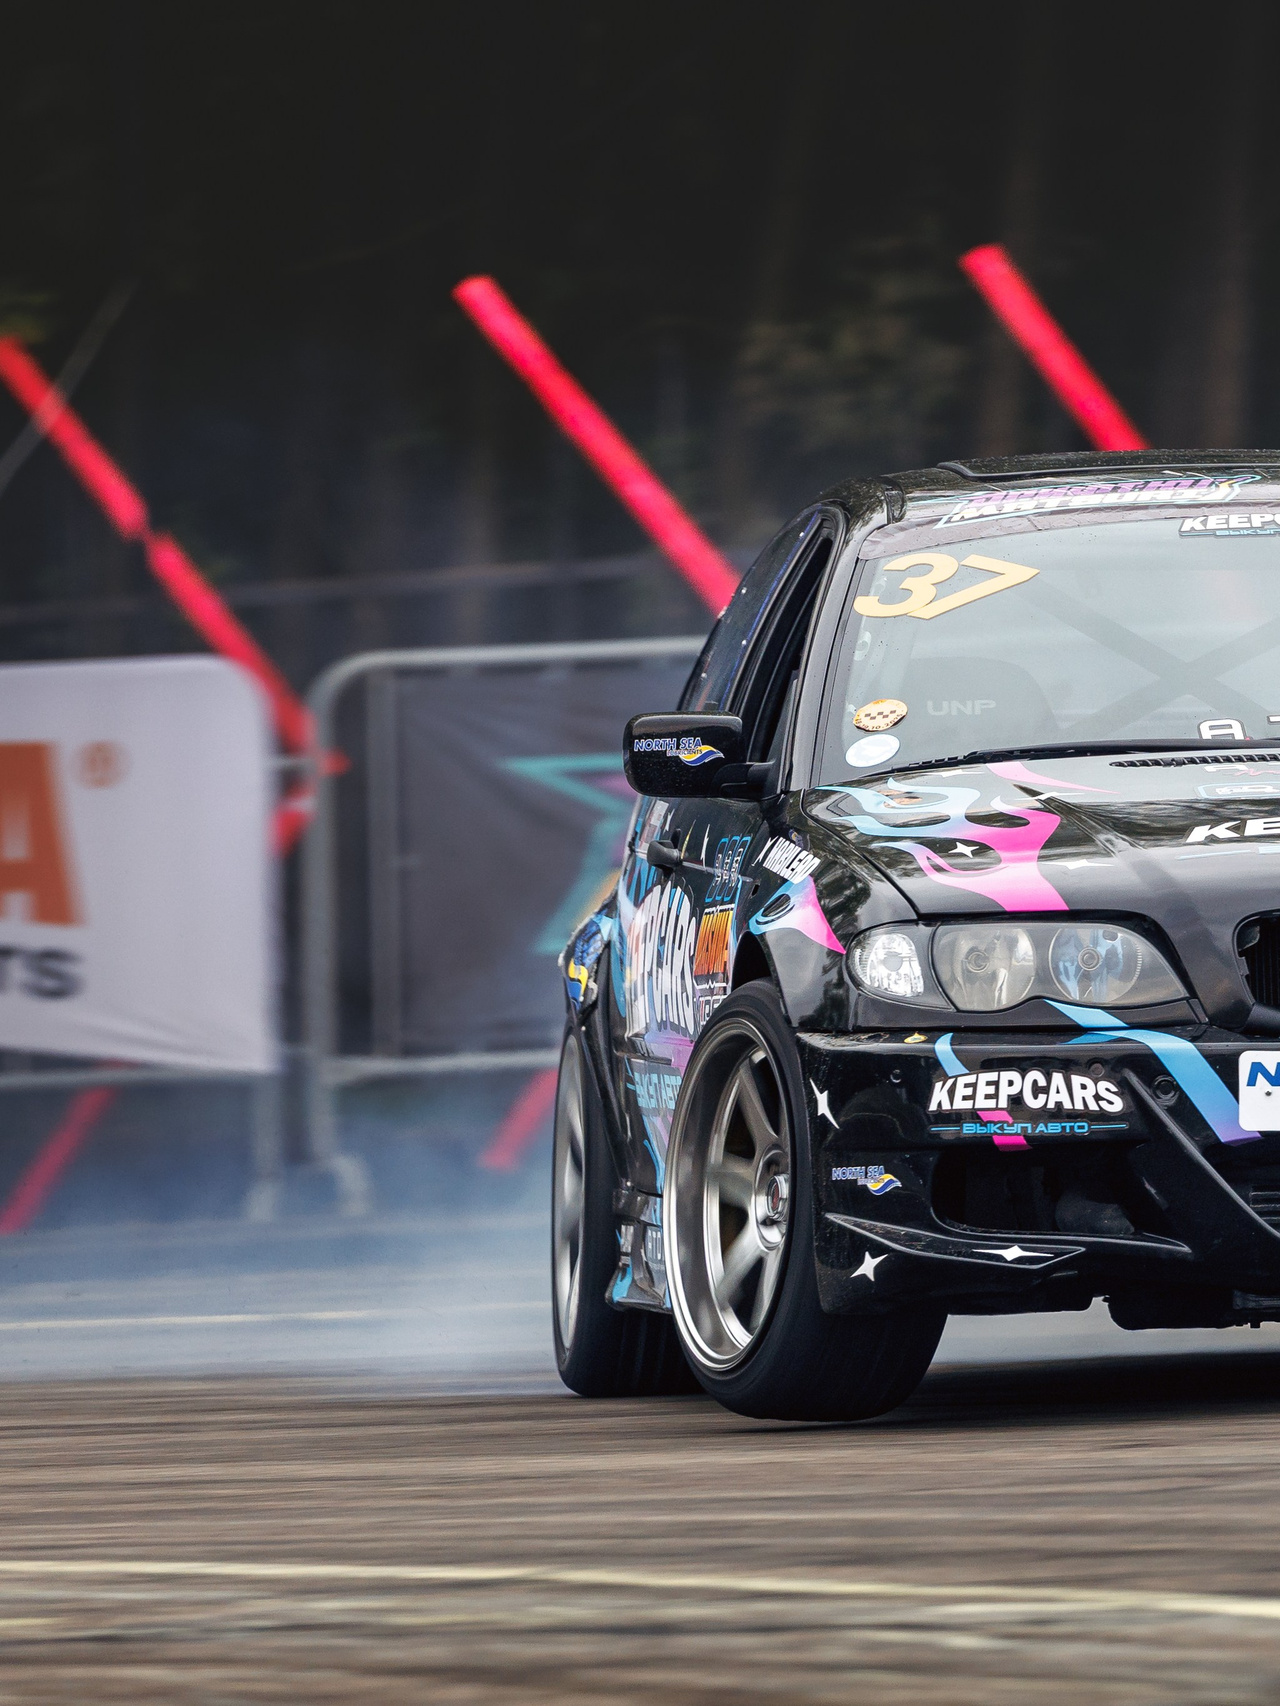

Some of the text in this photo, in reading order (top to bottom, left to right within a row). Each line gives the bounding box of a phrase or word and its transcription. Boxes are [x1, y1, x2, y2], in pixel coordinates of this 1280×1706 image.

[853, 552, 1040, 620] 37
[926, 699, 997, 716] UNP
[634, 737, 702, 751] NORTH SEA
[928, 1070, 1124, 1112] KEEPCARS
[962, 1122, 1088, 1134] ВЫКУП АВТО
[832, 1165, 885, 1180] NORTH SEA
